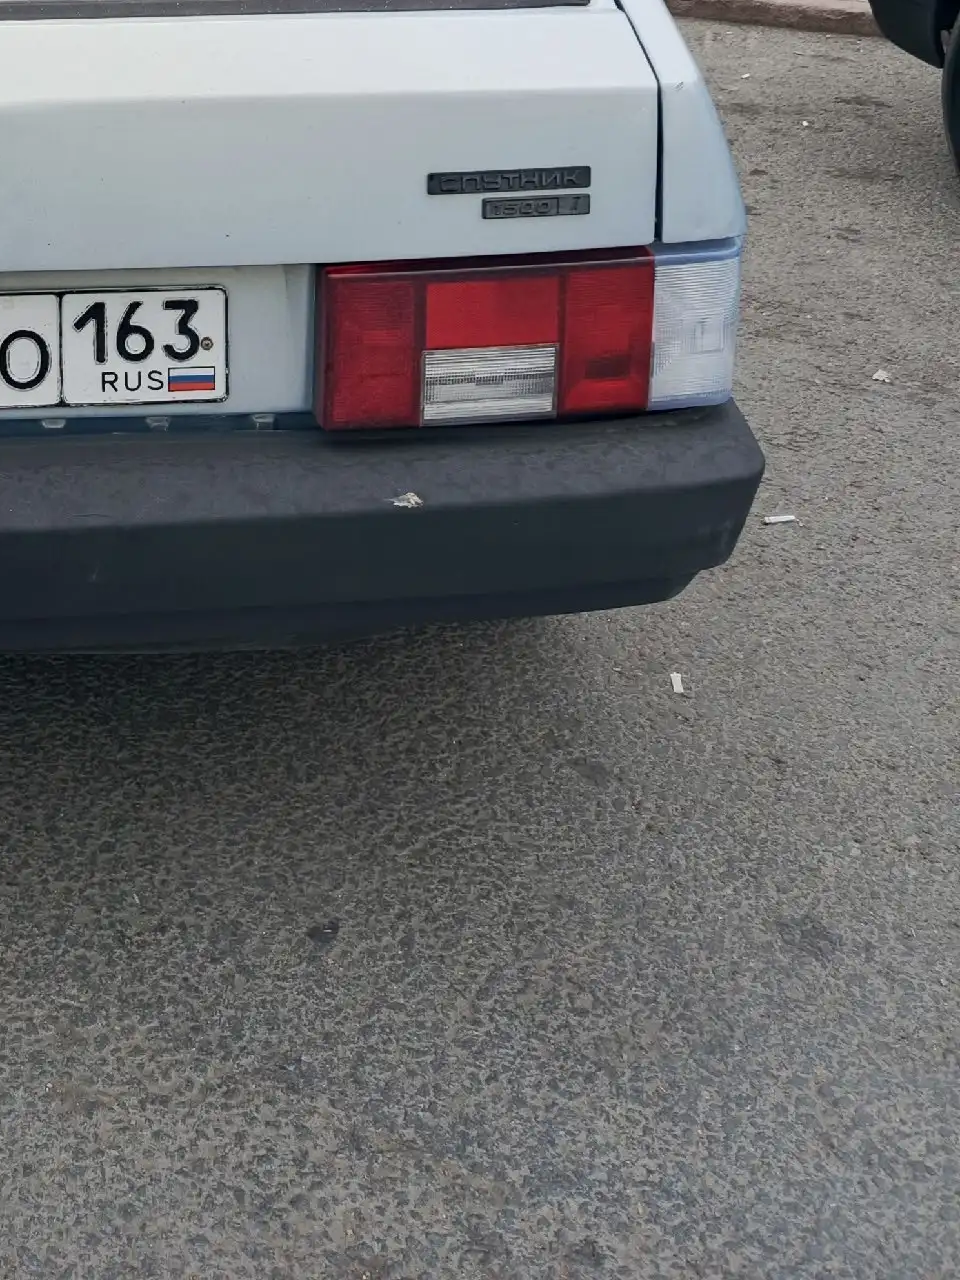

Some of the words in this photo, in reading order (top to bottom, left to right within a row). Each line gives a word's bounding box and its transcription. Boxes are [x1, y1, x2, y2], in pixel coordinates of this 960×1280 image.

[440, 171, 580, 192] СПУТНИК
[71, 299, 201, 365] 163
[100, 368, 164, 393] RUS
